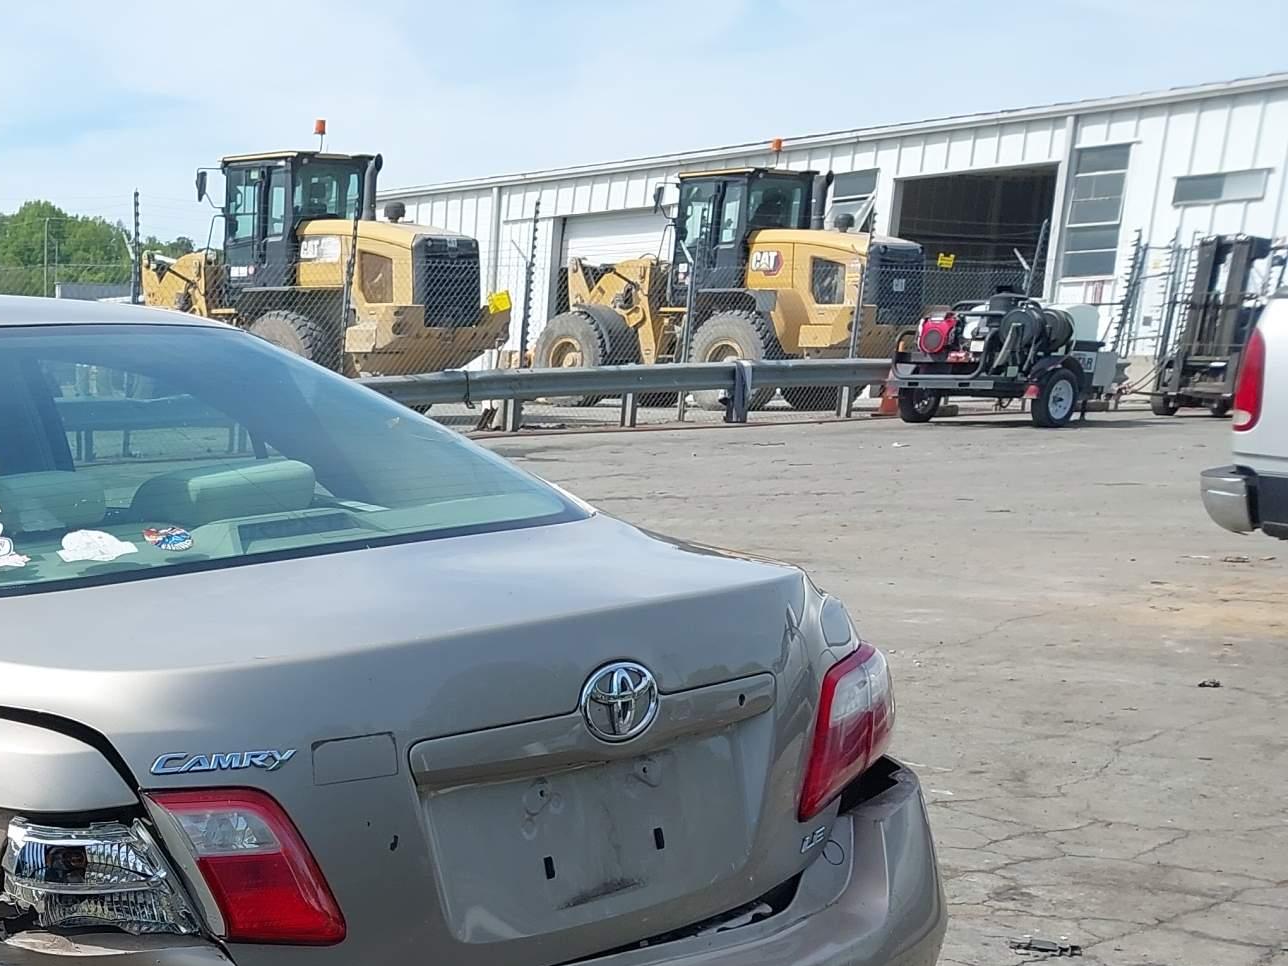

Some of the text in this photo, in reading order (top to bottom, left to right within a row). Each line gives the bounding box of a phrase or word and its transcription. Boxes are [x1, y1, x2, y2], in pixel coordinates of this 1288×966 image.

[300, 240, 320, 259] CAT
[752, 251, 778, 272] CAT
[151, 750, 296, 775] CAMRY
[800, 825, 827, 854] LE
